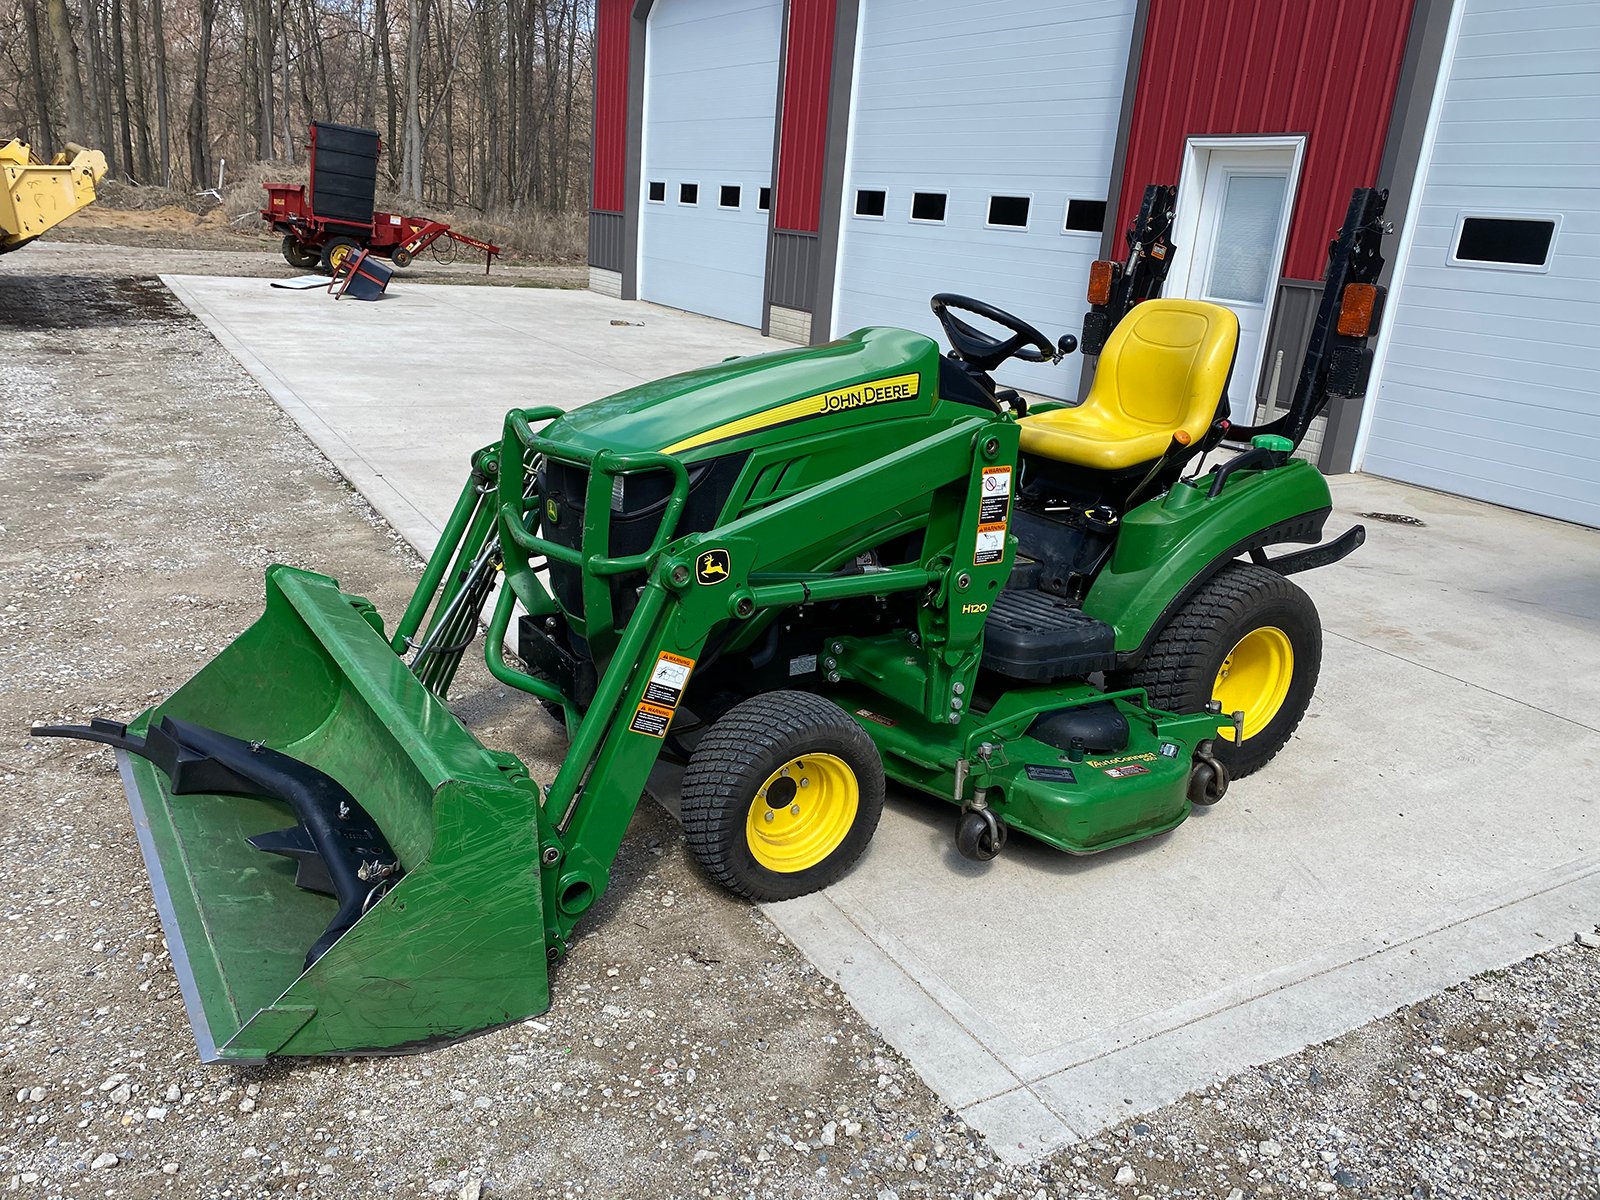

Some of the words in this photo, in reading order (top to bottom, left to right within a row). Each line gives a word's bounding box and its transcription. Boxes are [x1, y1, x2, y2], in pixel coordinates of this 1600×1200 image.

[820, 391, 862, 413] JOHN
[864, 384, 910, 402] DEERE
[962, 603, 988, 614] H120
[669, 655, 690, 666] WARNING
[648, 707, 670, 717] WARNING
